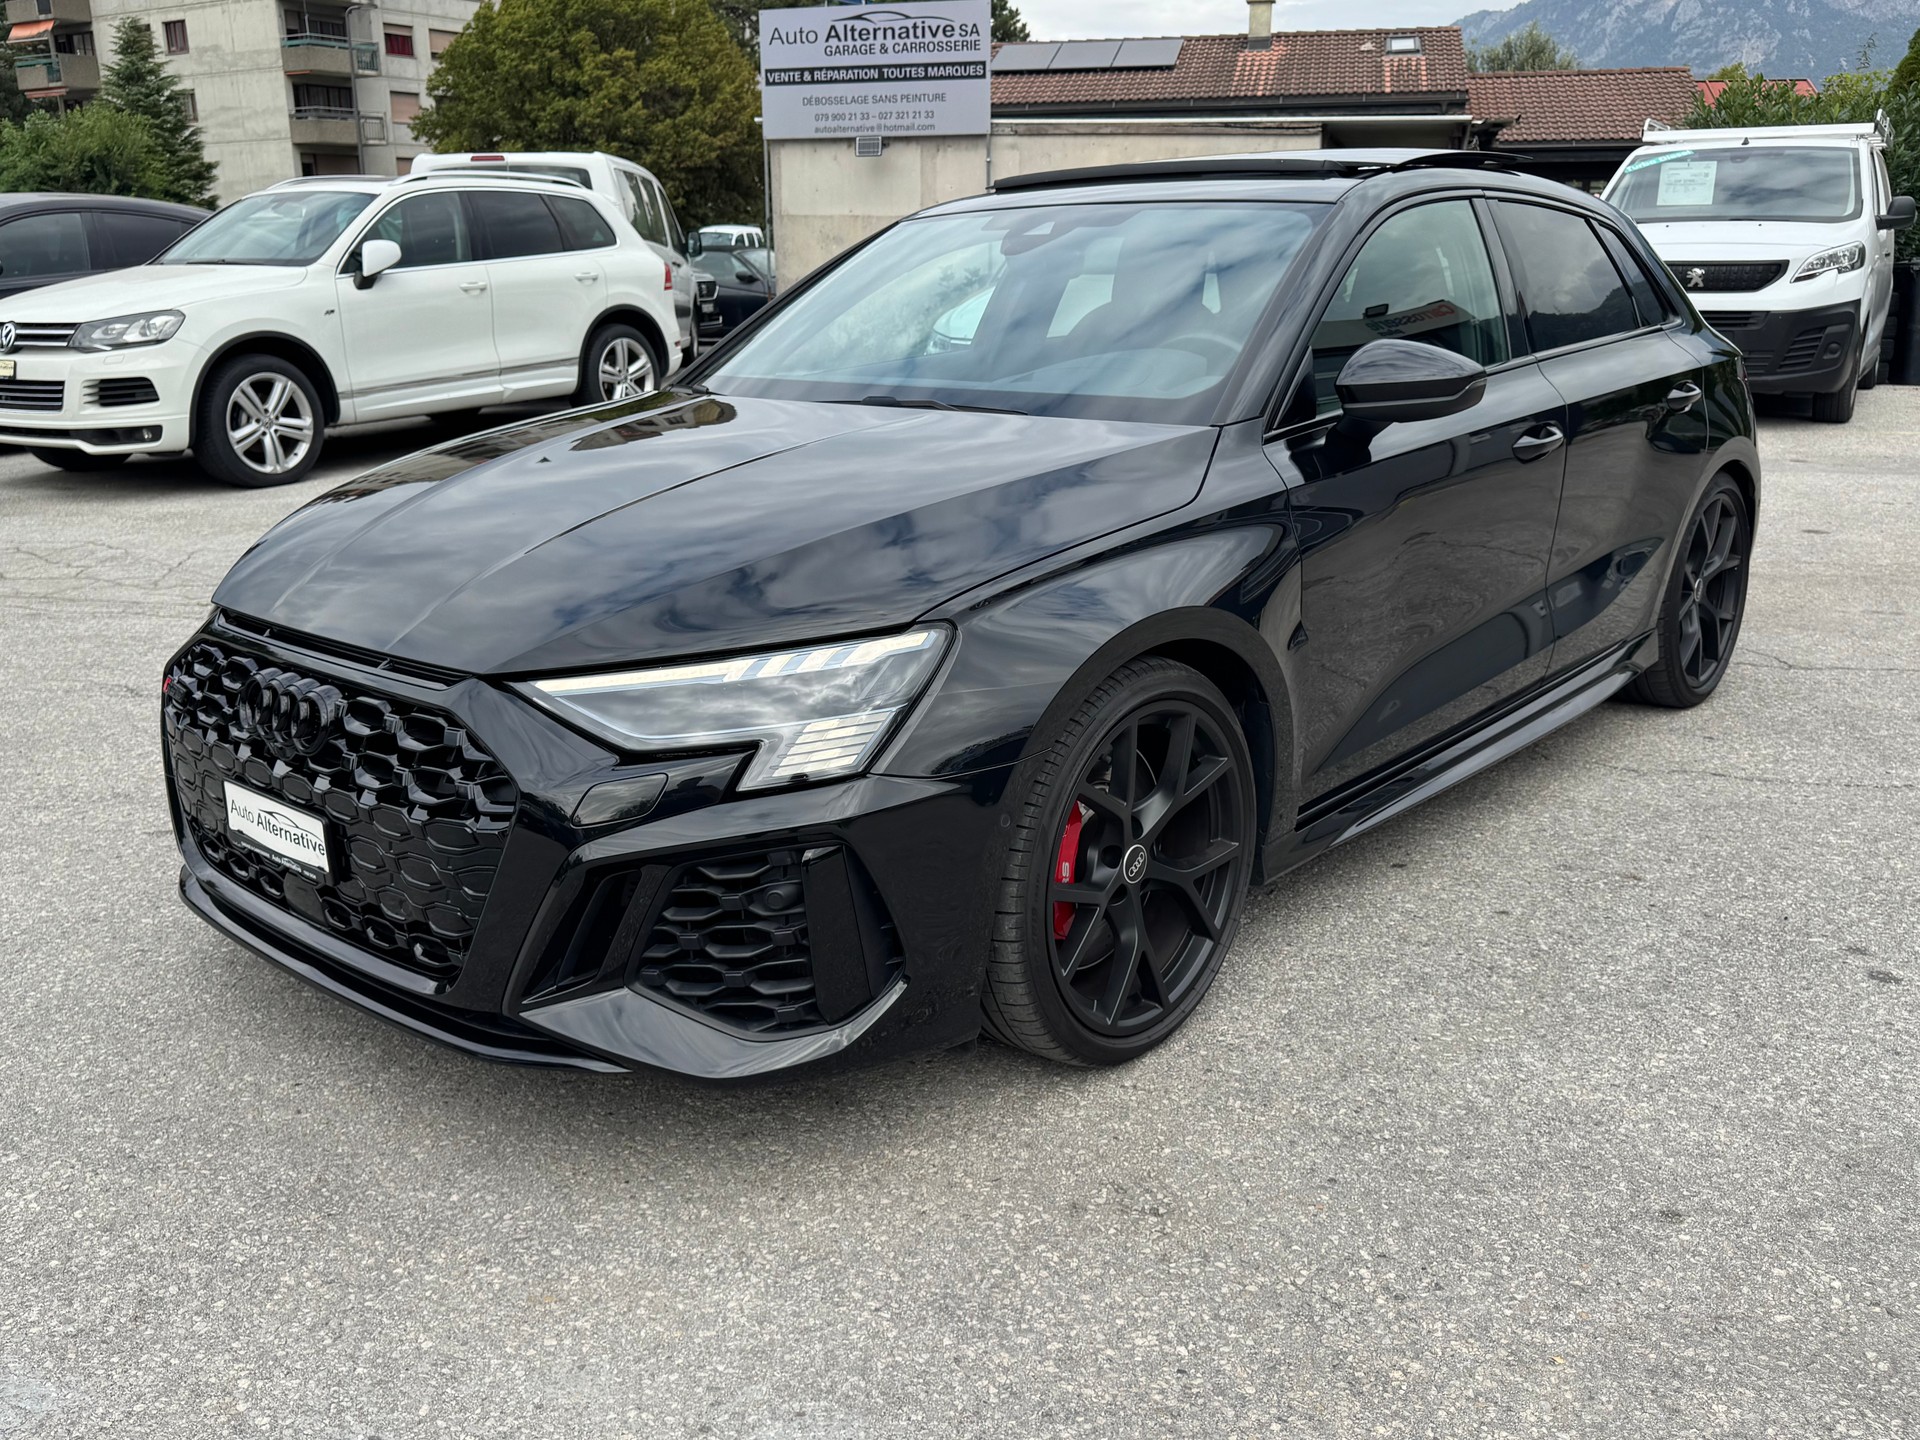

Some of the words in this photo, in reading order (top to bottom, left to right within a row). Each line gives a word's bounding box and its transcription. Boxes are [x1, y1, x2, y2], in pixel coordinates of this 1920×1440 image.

[769, 27, 818, 45] Auto
[824, 21, 955, 43] Alternative
[958, 23, 980, 37] SA
[824, 43, 876, 56] GARAGE
[879, 43, 889, 54] &
[892, 39, 981, 54] CARROSSERIE
[767, 71, 801, 83] VENTE
[803, 71, 812, 81] &
[814, 68, 878, 81] RÉPARATION
[882, 67, 925, 79] TOUTES
[927, 65, 984, 77] MARQUES
[802, 94, 869, 106] DÉBOSSELAGE
[872, 94, 898, 104] SANS
[900, 93, 947, 103] PEINTURE
[814, 113, 830, 122] 079
[831, 113, 846, 121] 900
[848, 112, 857, 121] 21
[860, 112, 870, 120] 33
[878, 111, 893, 120] 027
[895, 111, 909, 119] 321
[912, 111, 921, 119] 21
[924, 110, 935, 119] 33
[231, 799, 254, 823] Auto
[257, 813, 325, 856] Alternative
